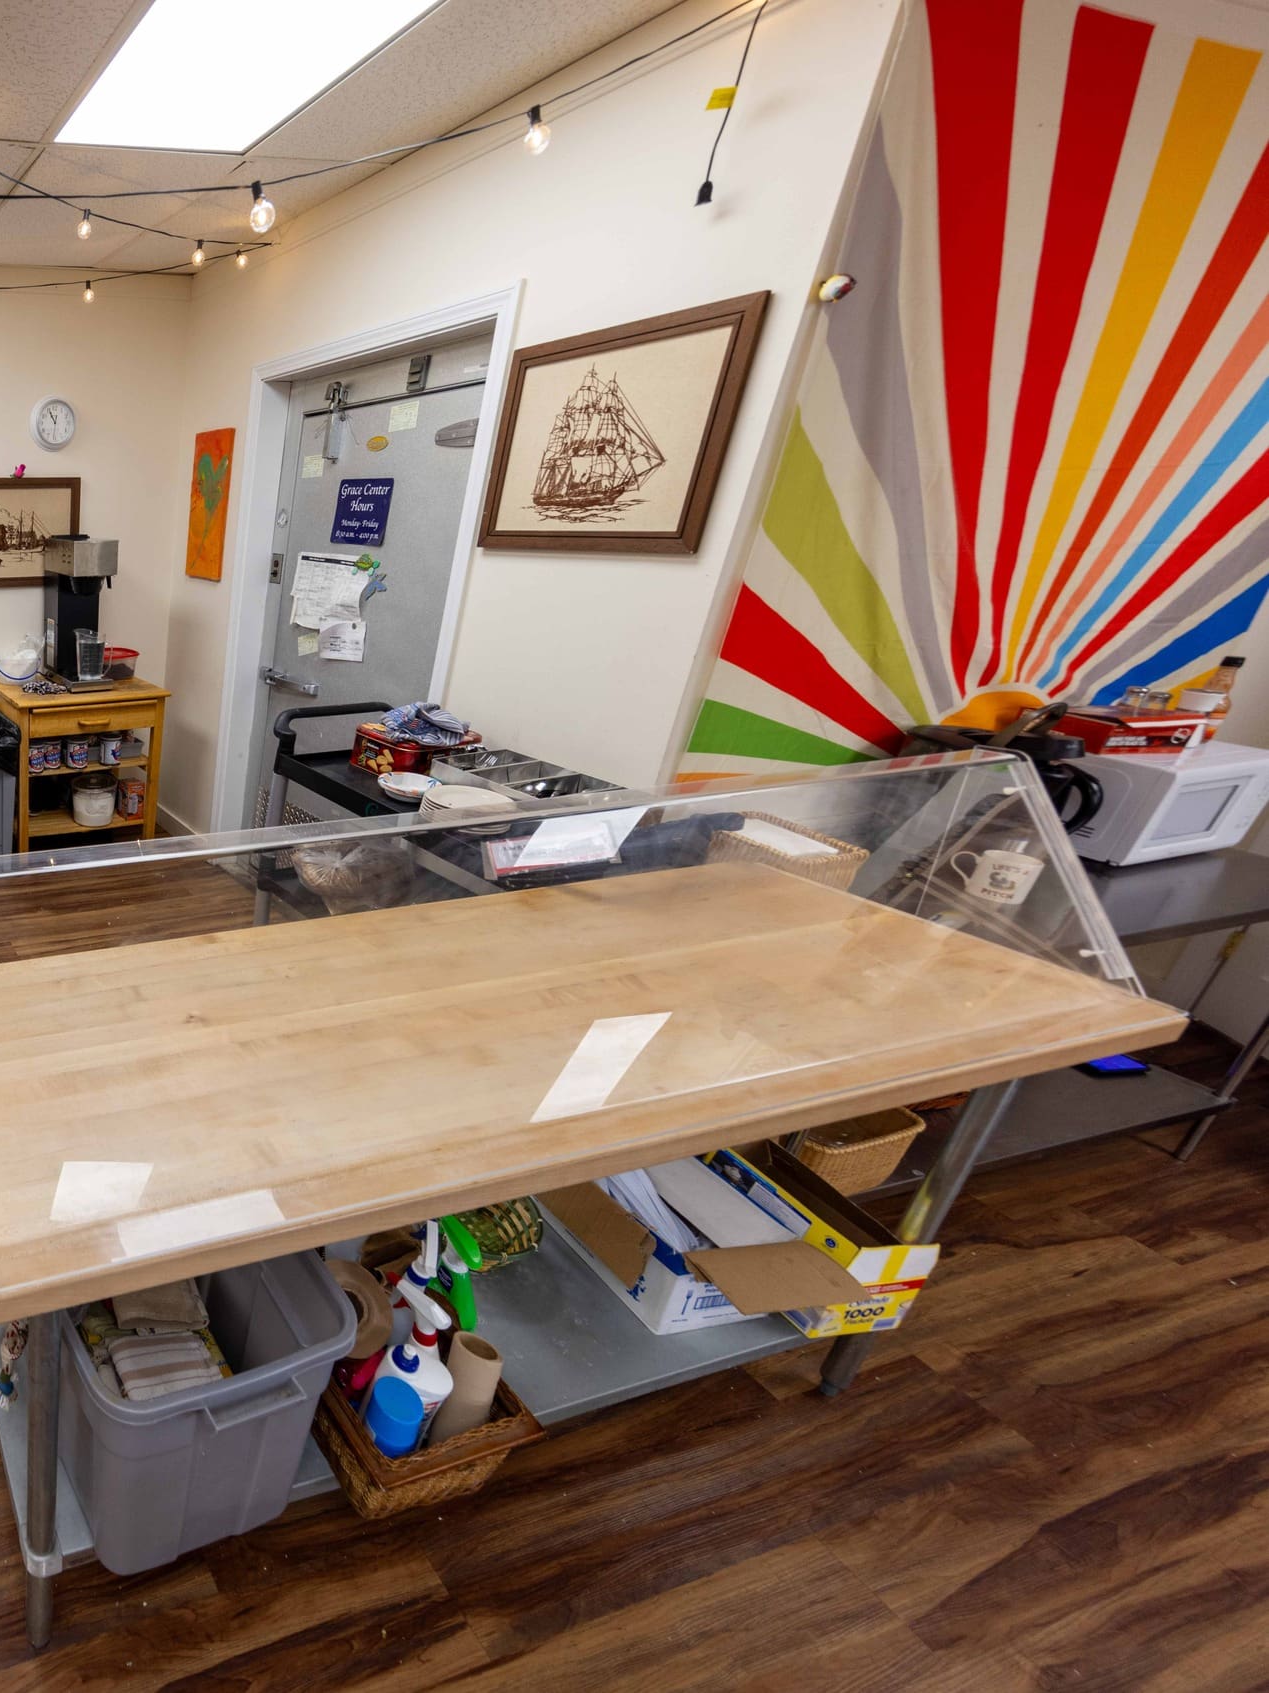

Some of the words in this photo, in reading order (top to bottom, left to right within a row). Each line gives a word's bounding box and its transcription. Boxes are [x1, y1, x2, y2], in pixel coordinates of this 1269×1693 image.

[341, 484, 363, 499] Grace
[363, 483, 391, 496] Center
[350, 497, 375, 512] Hours
[843, 1306, 885, 1319] 1000
